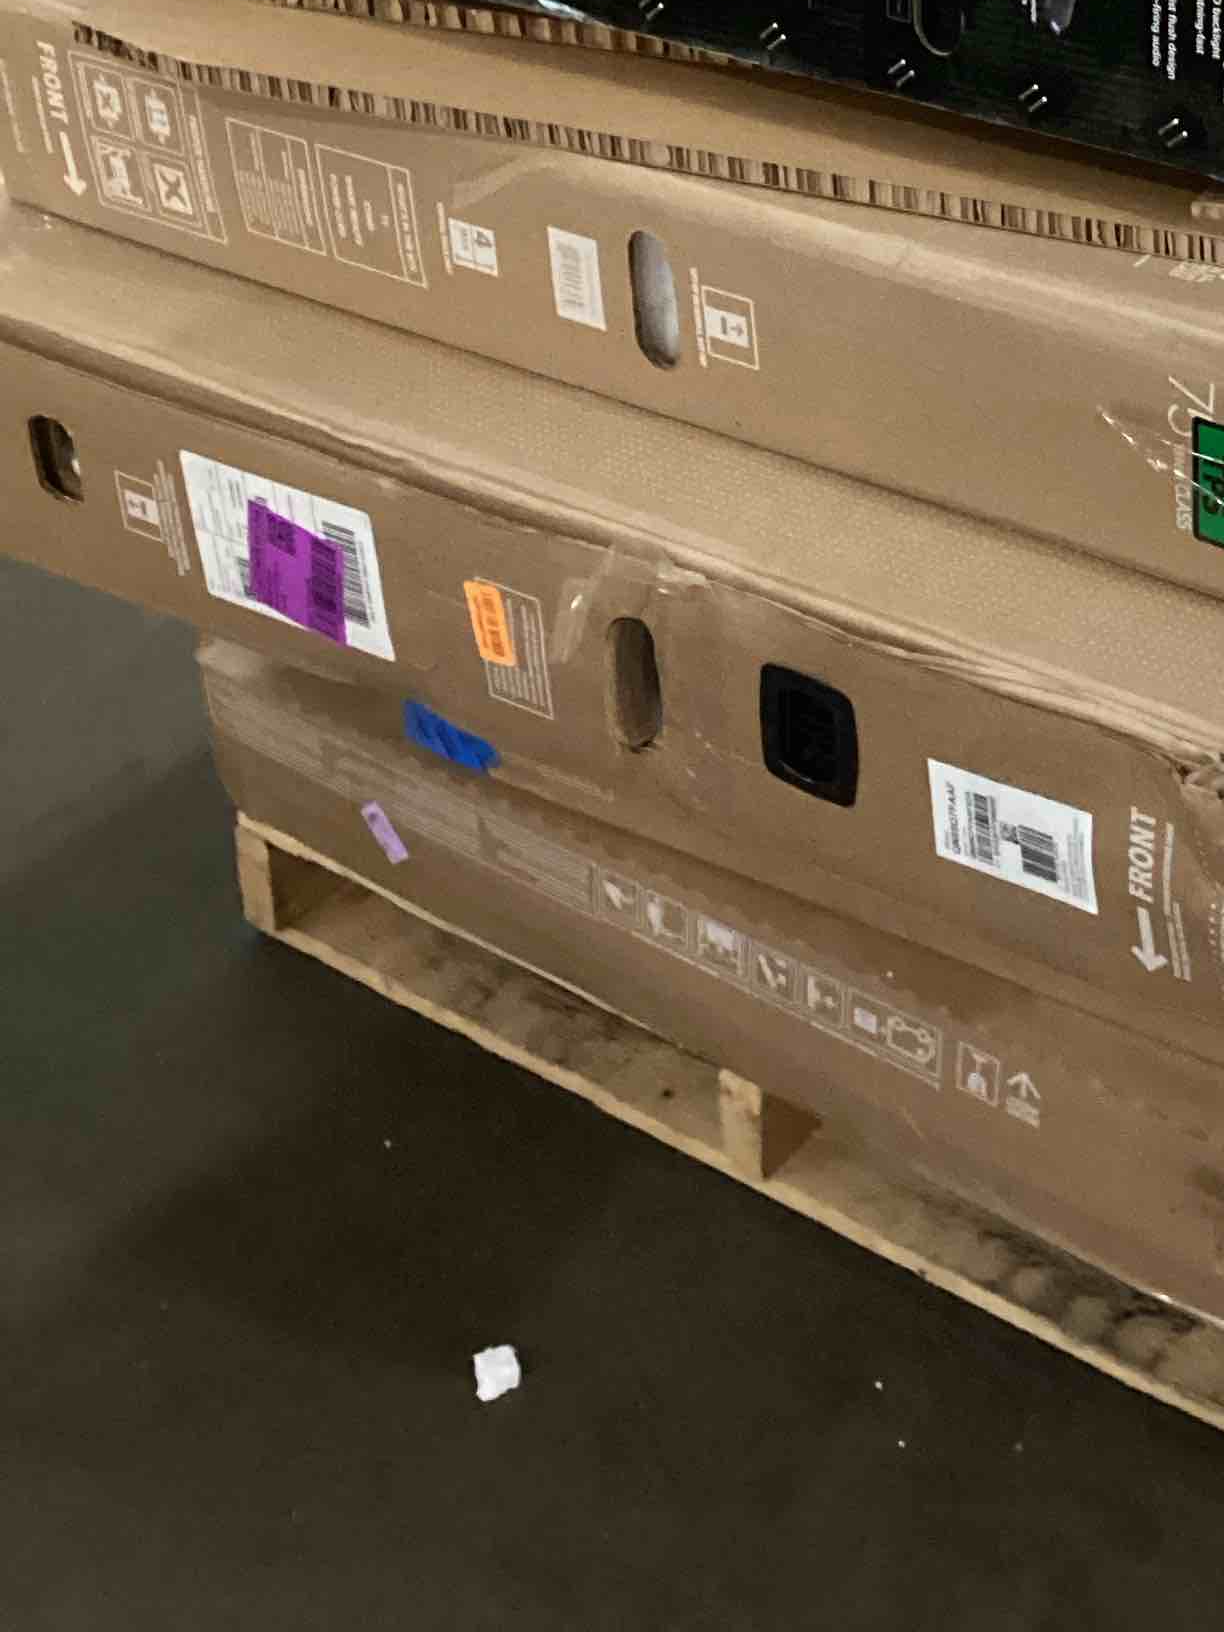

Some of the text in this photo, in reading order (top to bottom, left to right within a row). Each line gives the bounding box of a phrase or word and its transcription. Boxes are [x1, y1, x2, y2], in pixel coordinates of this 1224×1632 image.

[1167, 13, 1178, 41] flush
[1210, 7, 1221, 60] backlight
[1151, 35, 1161, 67] audio
[1165, 42, 1177, 80] design
[36, 40, 70, 126] FRONT
[1127, 805, 1157, 904] FRONT
